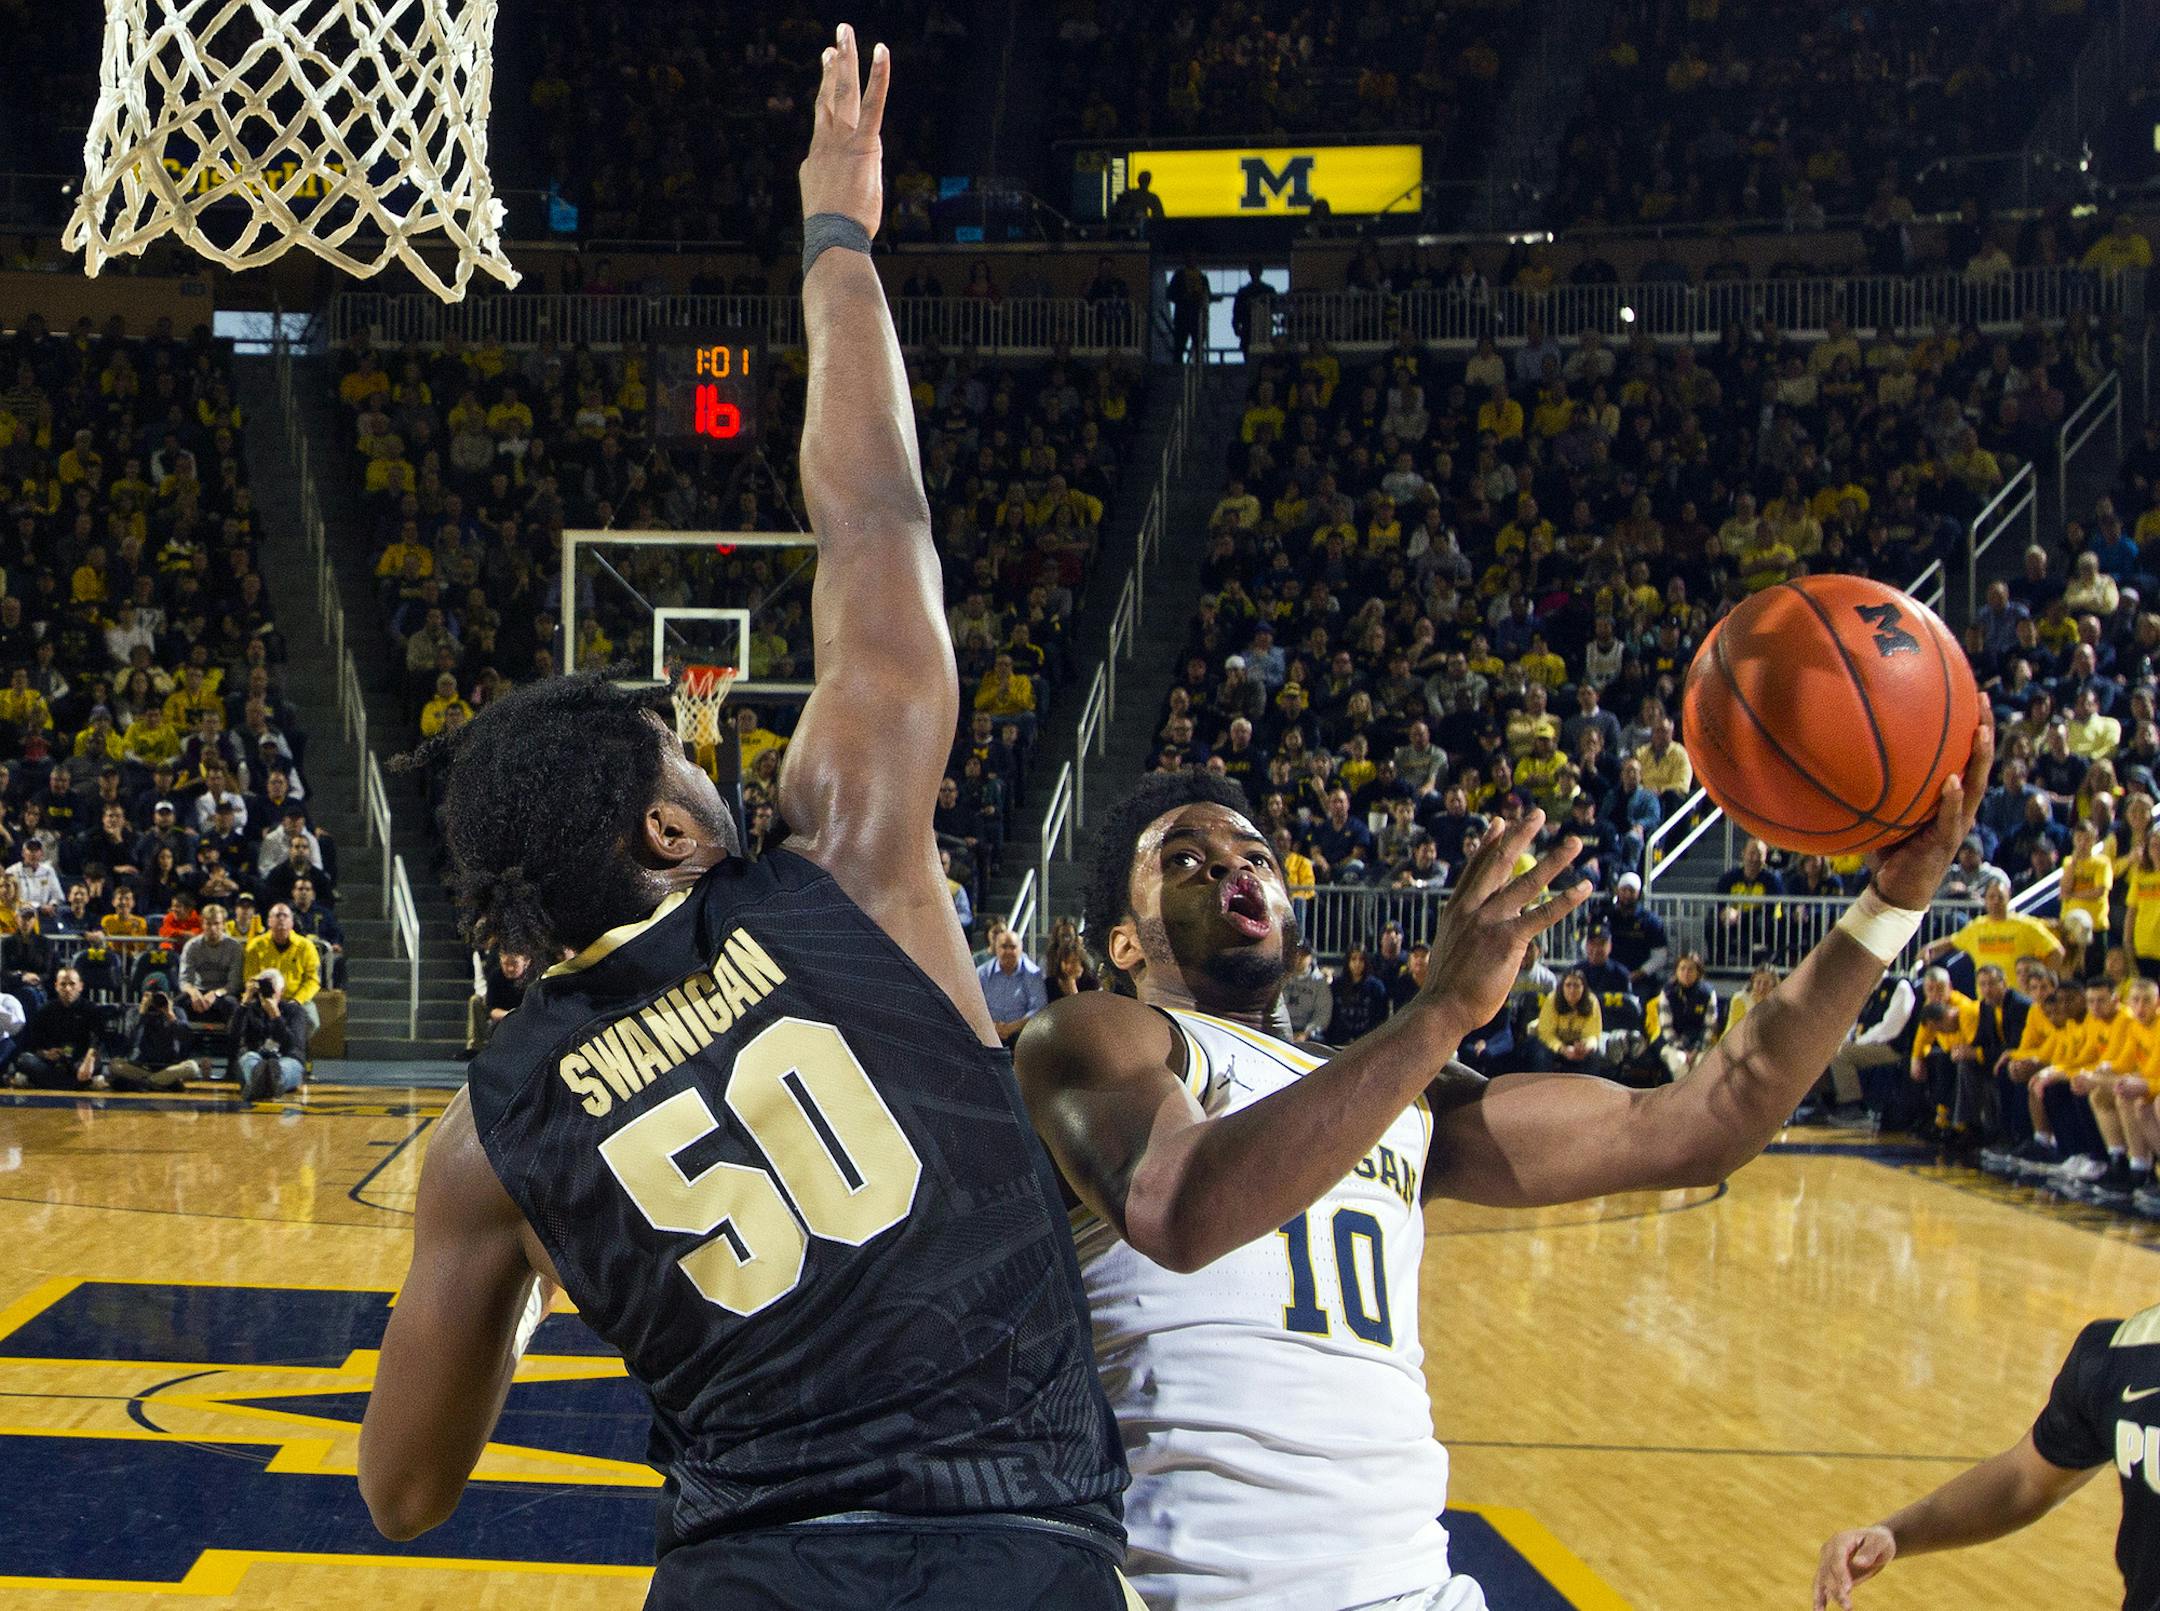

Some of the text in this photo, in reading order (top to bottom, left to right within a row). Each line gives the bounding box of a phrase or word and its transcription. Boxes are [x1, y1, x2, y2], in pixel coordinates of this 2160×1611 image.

[1240, 156, 1316, 210] M
[696, 345, 750, 378] 1:01
[695, 383, 741, 439] 16
[1853, 602, 1921, 658] M
[559, 927, 788, 1118] SWANIGAN
[597, 1016, 923, 1317] 50
[1276, 1207, 1394, 1351] 10
